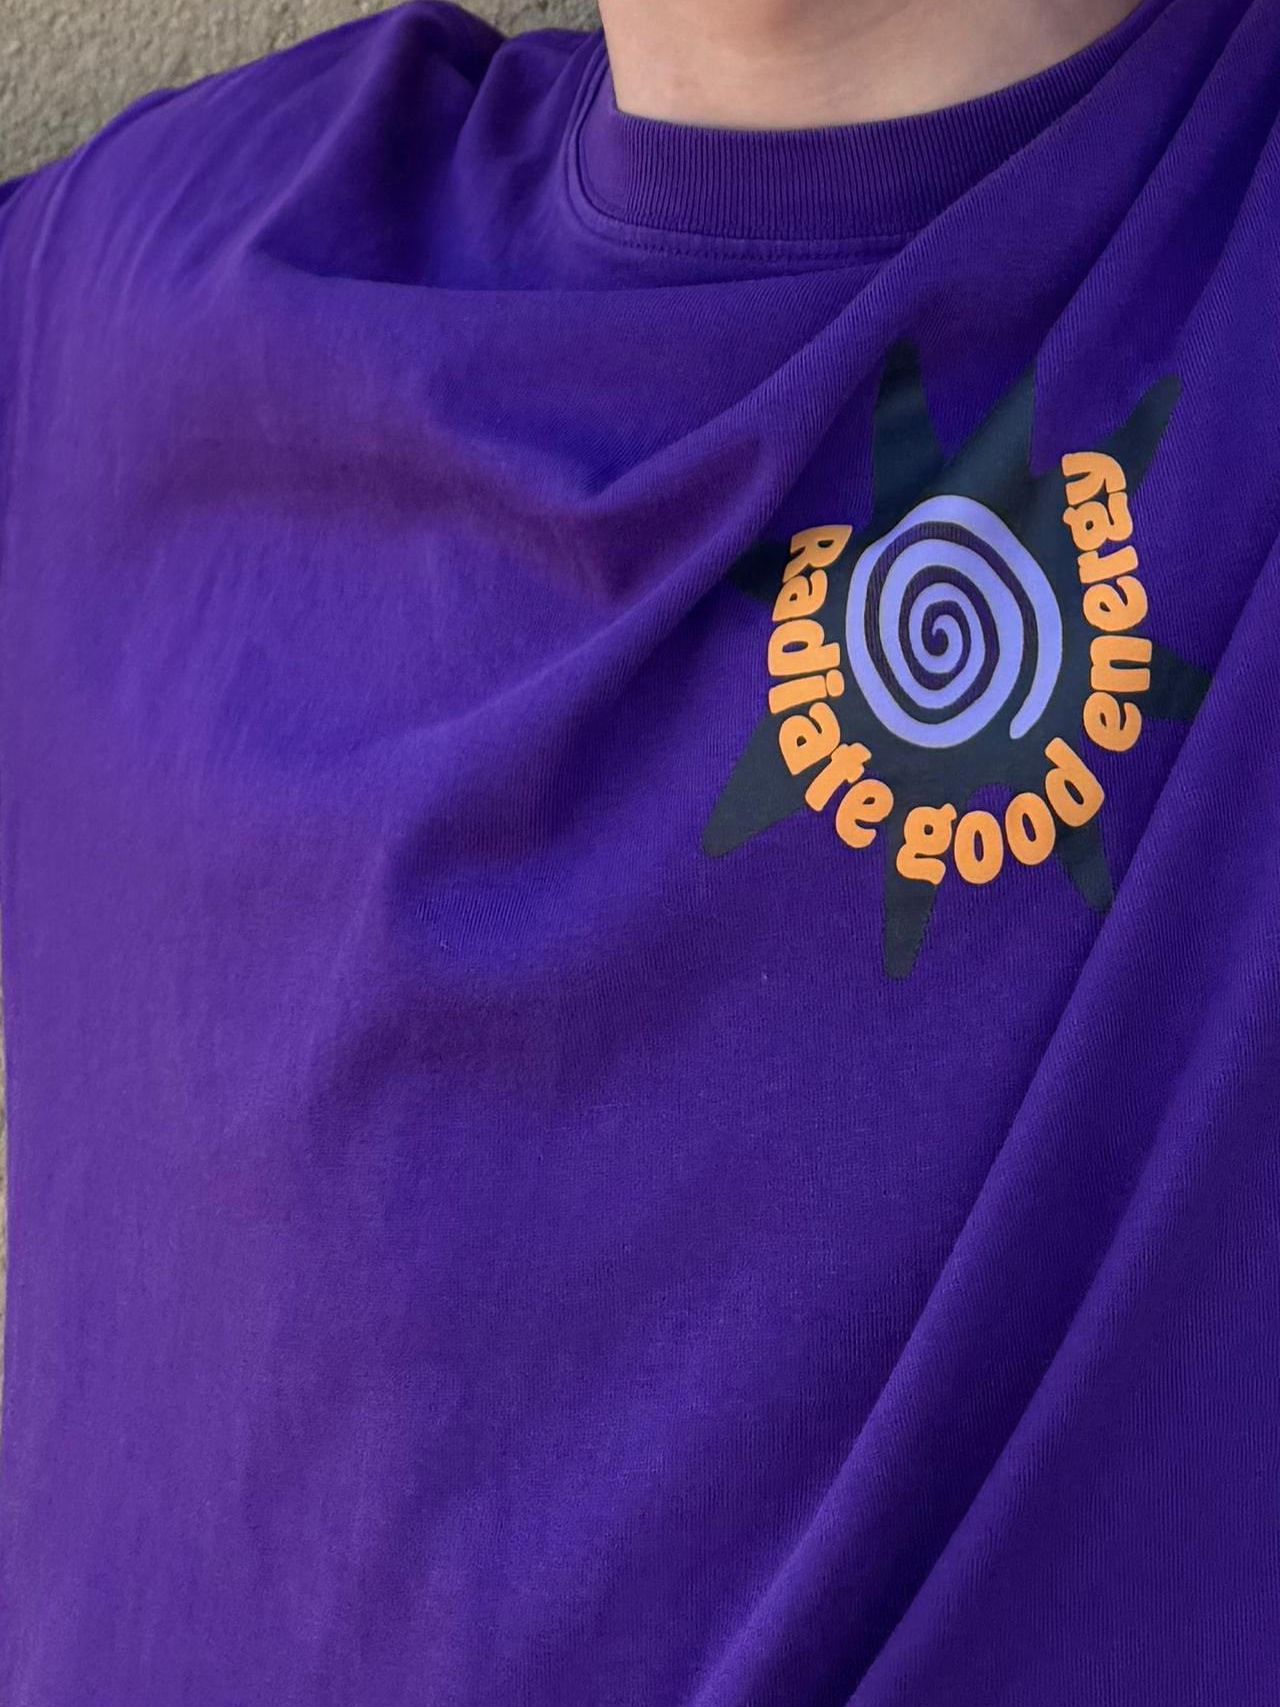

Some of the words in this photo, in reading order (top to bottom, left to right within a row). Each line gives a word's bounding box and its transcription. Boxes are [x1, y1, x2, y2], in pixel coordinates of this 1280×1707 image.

[767, 524, 894, 849] Radiate
[895, 737, 1105, 886] good
[1061, 452, 1153, 752] energy
